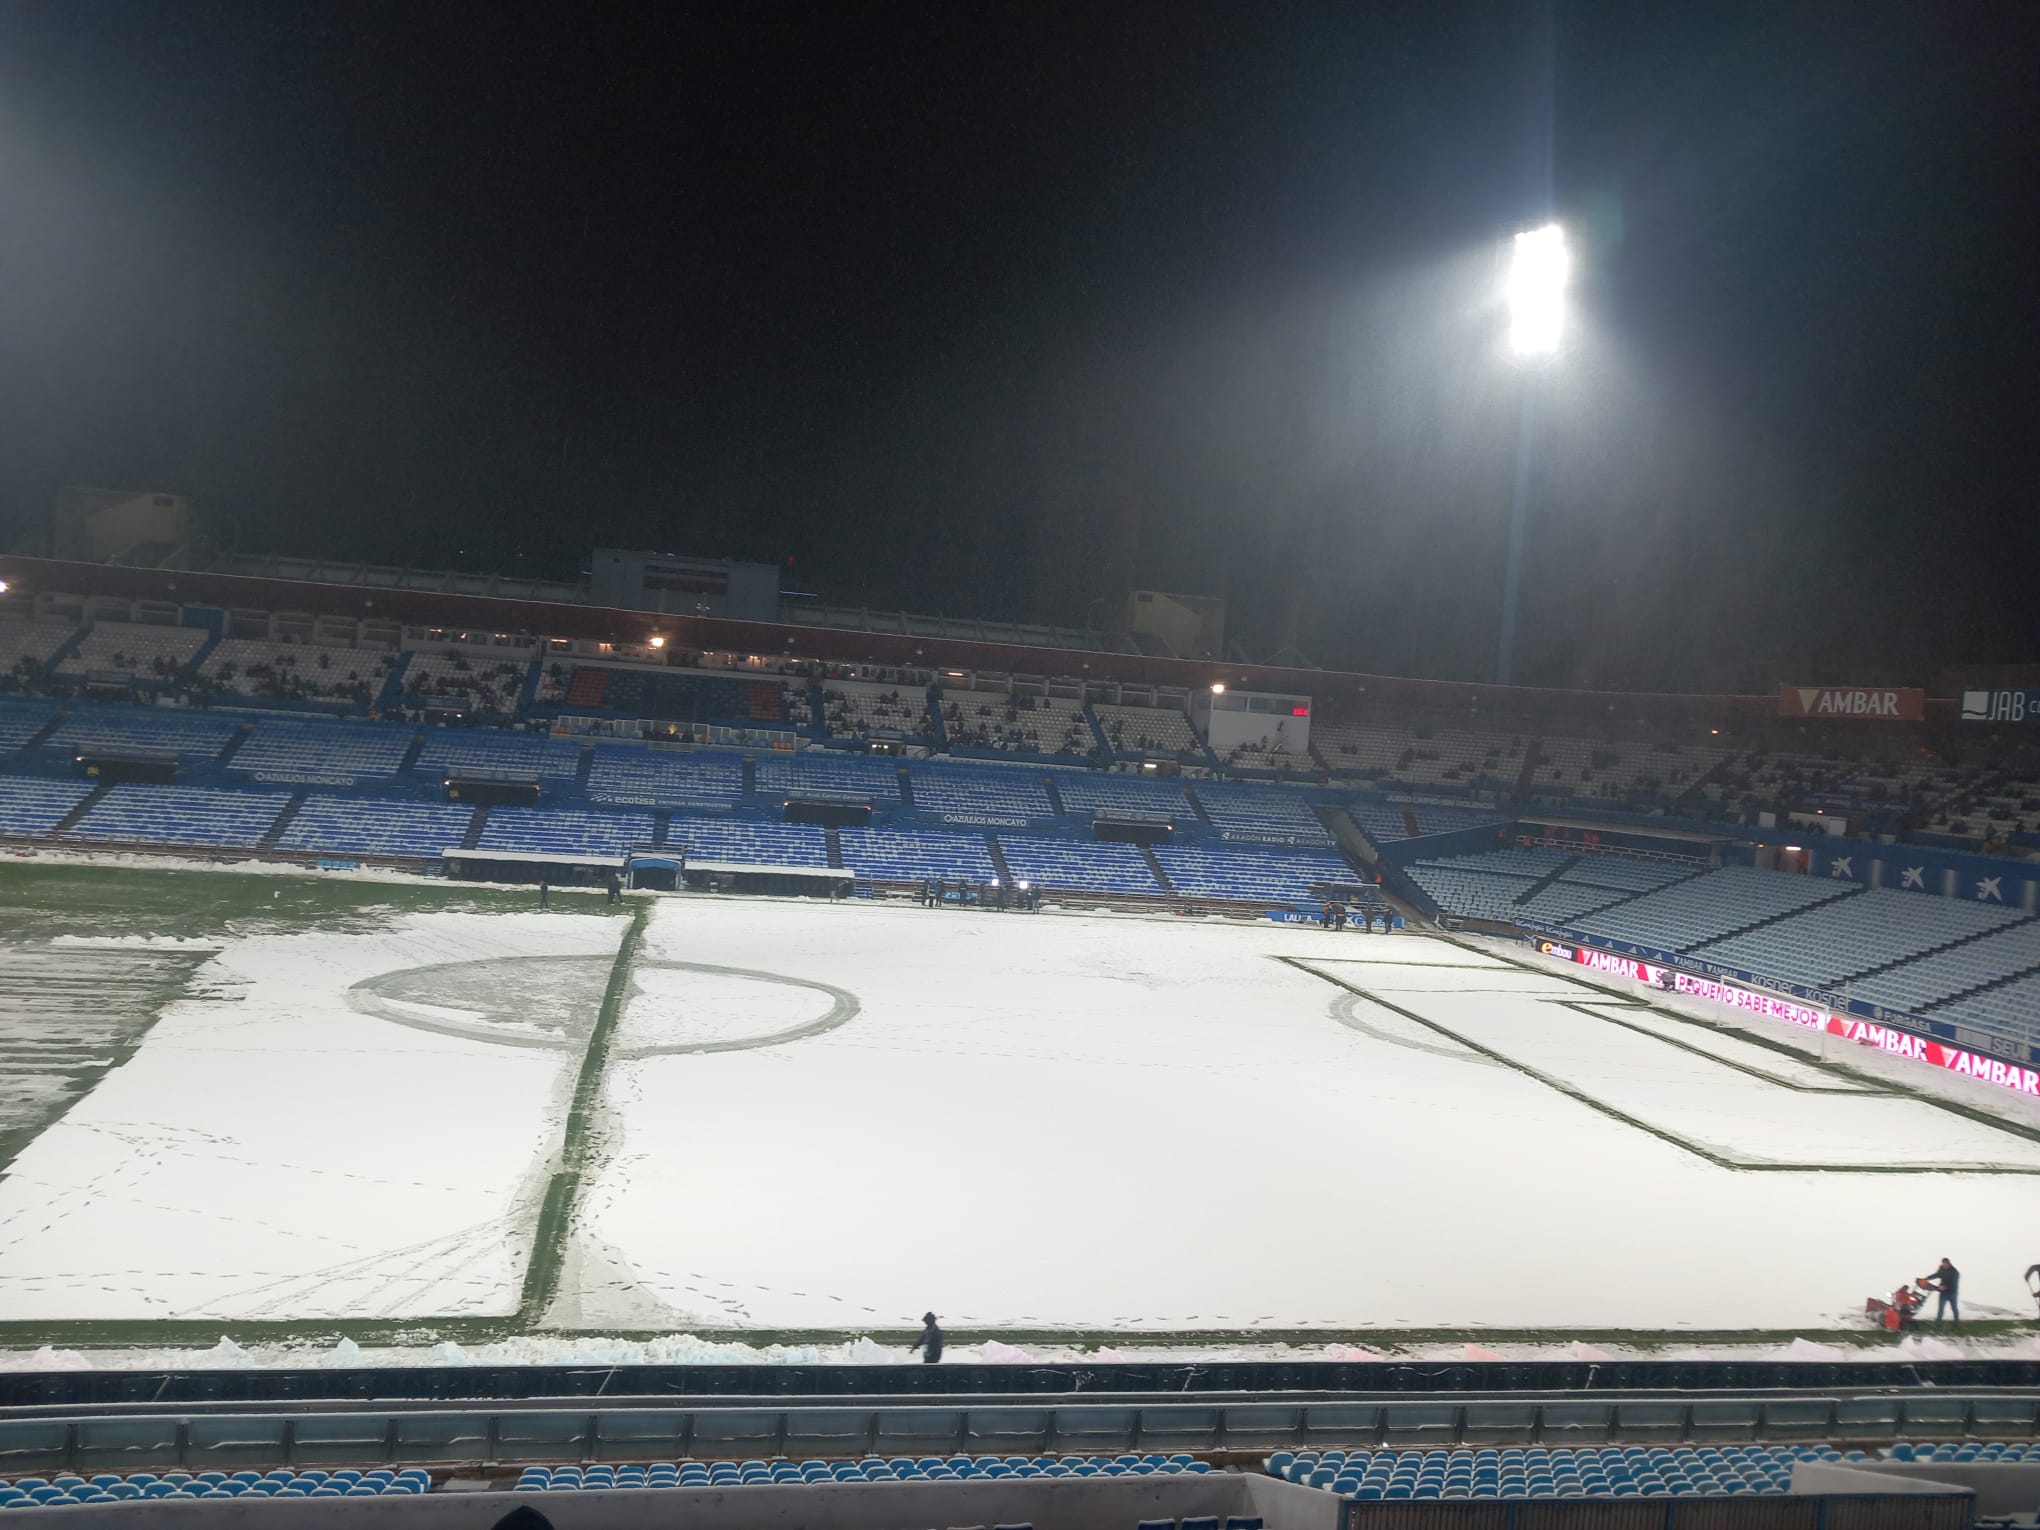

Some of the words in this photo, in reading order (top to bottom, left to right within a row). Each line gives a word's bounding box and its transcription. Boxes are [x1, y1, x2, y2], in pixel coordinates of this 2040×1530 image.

[1818, 691, 1900, 715] AMBAR
[1988, 691, 2025, 720] JAB
[987, 817, 1027, 827] MONCAYO
[1541, 942, 1573, 959] embou
[1590, 954, 1639, 978] AMBAR
[1737, 991, 1769, 1014] SABE
[1770, 1001, 1819, 1028] MEJOR
[1853, 1022, 1928, 1062] AMBAR
[1954, 1050, 2040, 1095] AMBAR
